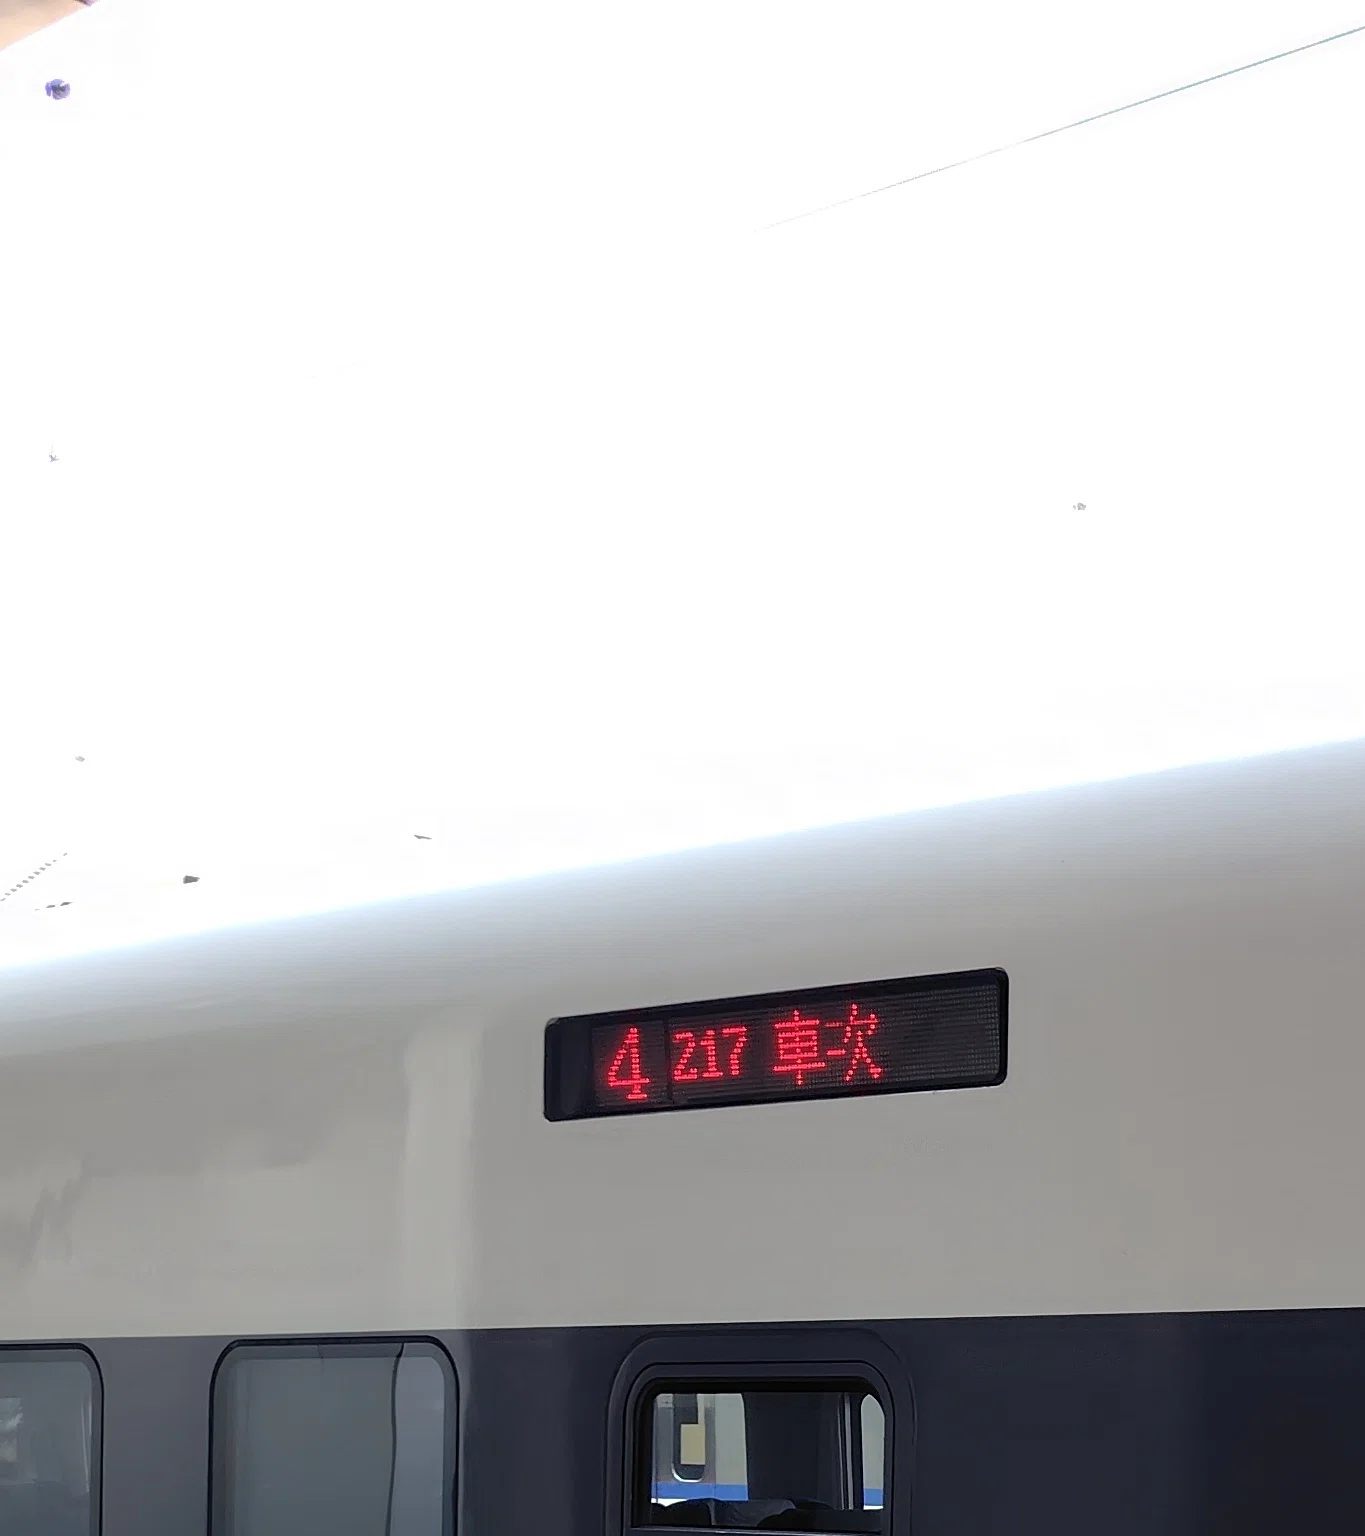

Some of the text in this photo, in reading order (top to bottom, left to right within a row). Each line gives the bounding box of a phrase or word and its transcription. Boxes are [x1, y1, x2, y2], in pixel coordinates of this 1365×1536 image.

[606, 1003, 883, 1100] 4 217 車次
